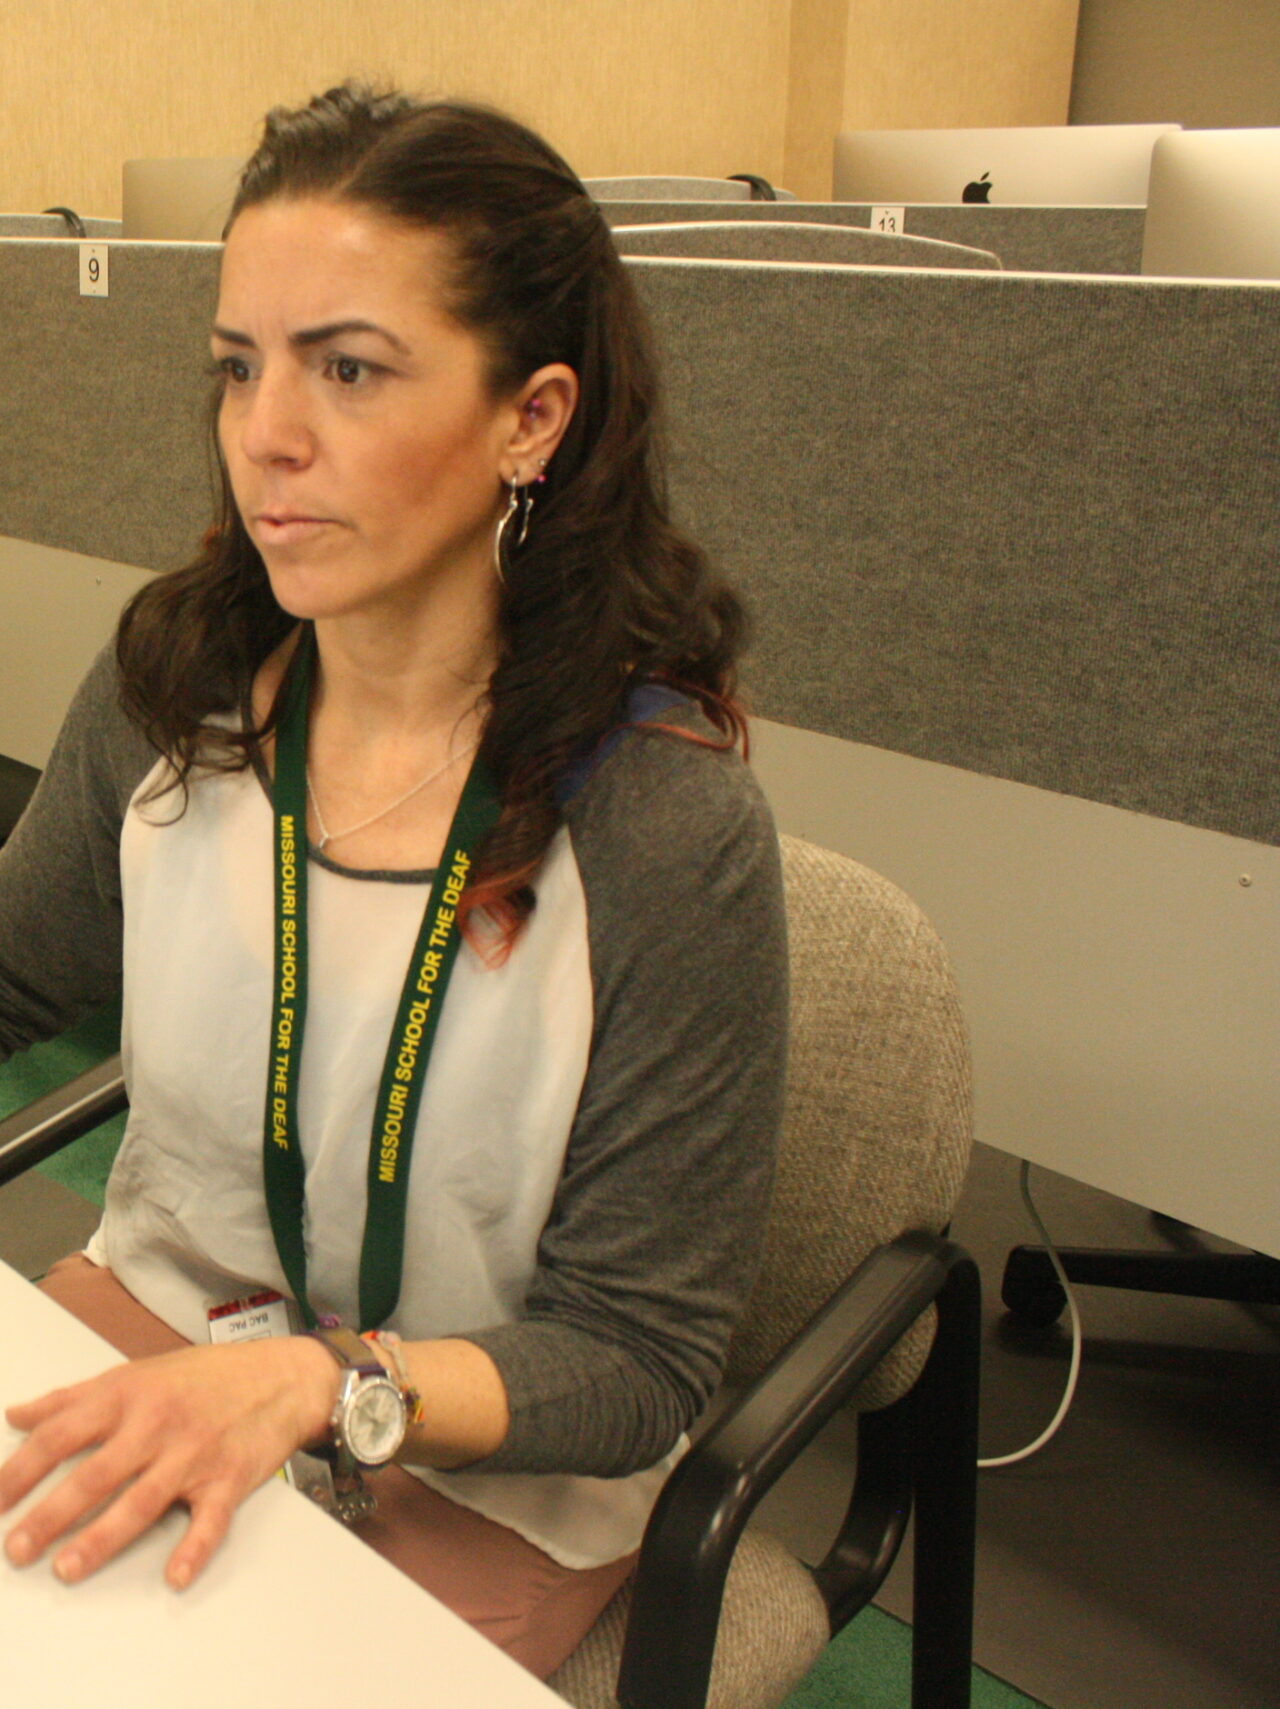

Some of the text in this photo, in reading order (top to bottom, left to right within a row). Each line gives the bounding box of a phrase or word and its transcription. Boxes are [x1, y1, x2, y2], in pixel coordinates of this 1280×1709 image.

[89, 258, 99, 282] 9
[879, 217, 896, 233] 13
[273, 815, 297, 1150] MISSOURI SCHOOL FOR THE DEAF
[379, 849, 471, 1183] MISSOURI SCHOOL FOR THE DEAF
